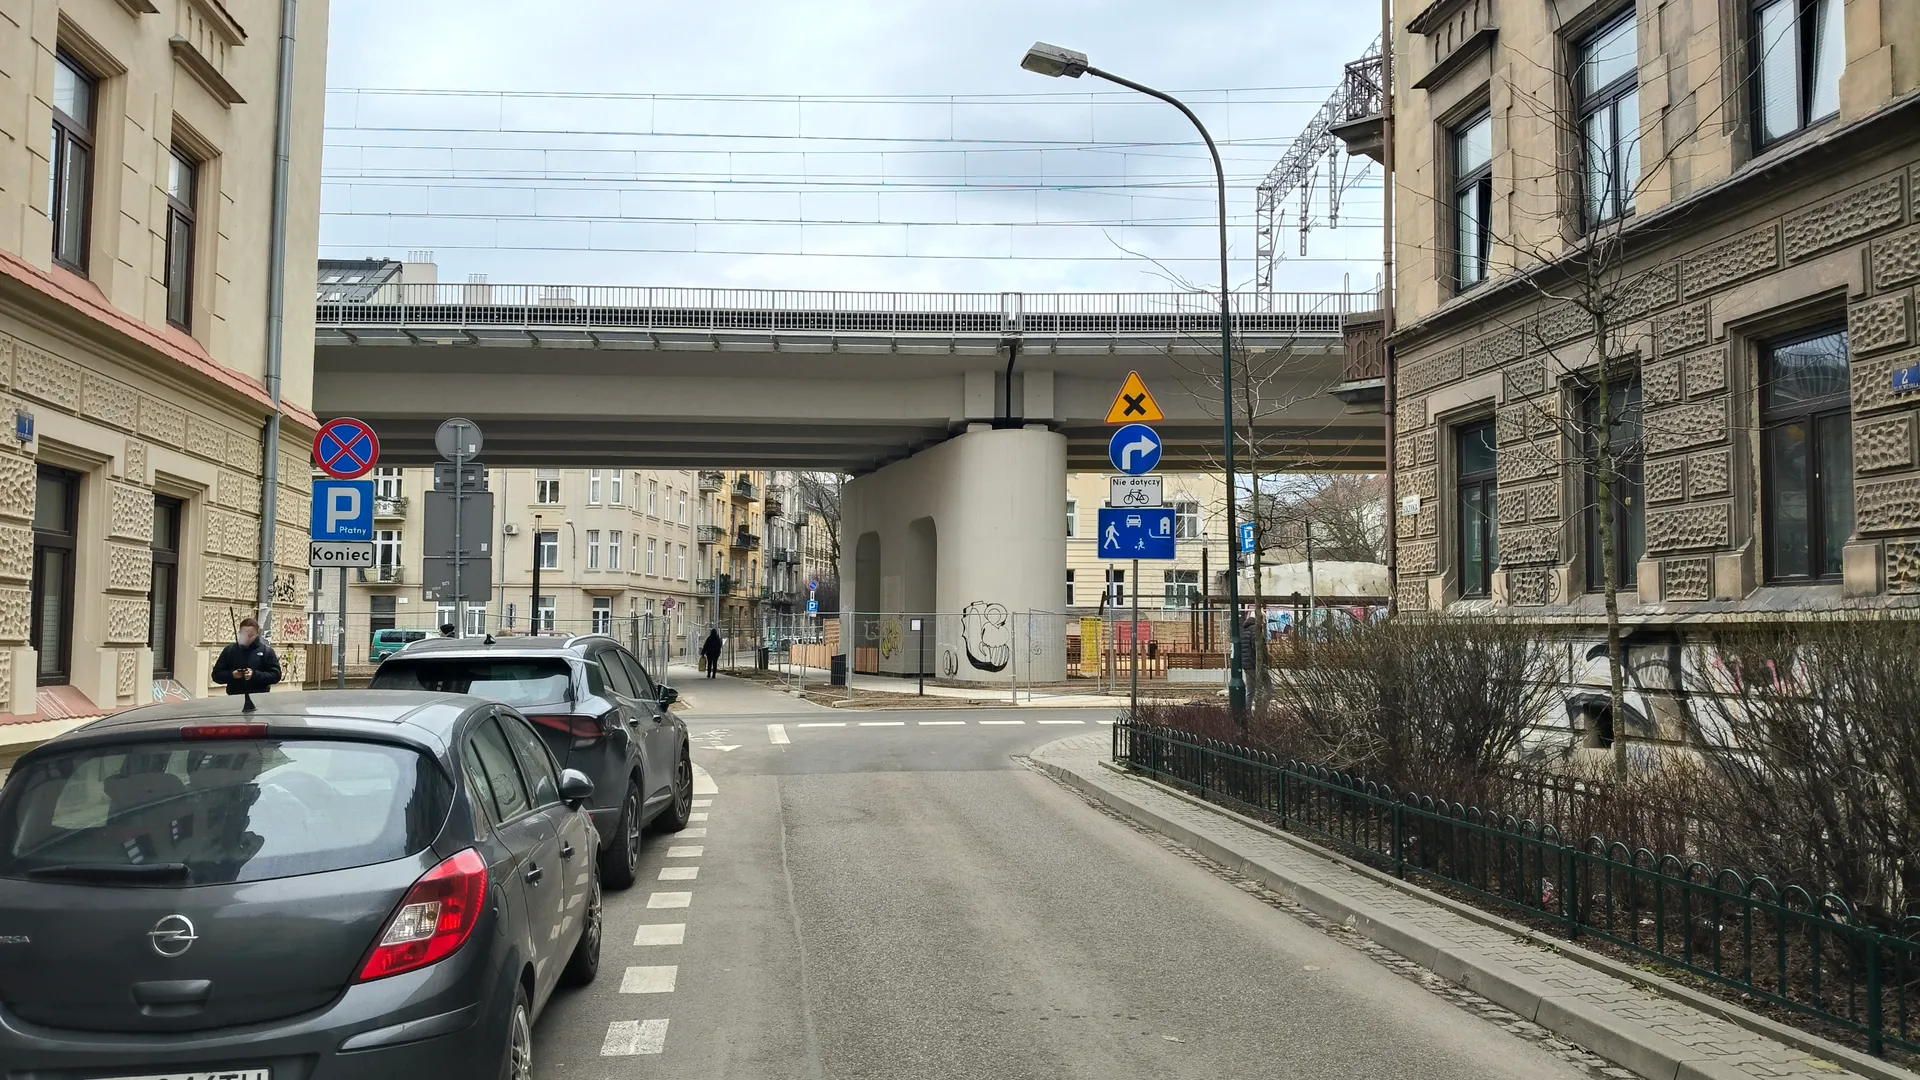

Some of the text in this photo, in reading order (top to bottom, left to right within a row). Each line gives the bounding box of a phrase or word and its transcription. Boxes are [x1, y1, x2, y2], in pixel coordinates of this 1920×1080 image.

[1901, 368, 1909, 385] 2
[1112, 478, 1161, 487] Nie dotyczy
[326, 487, 361, 534] P
[339, 526, 367, 536] Płatny
[312, 546, 370, 561] Koniec
[0, 935, 31, 944] RSA
